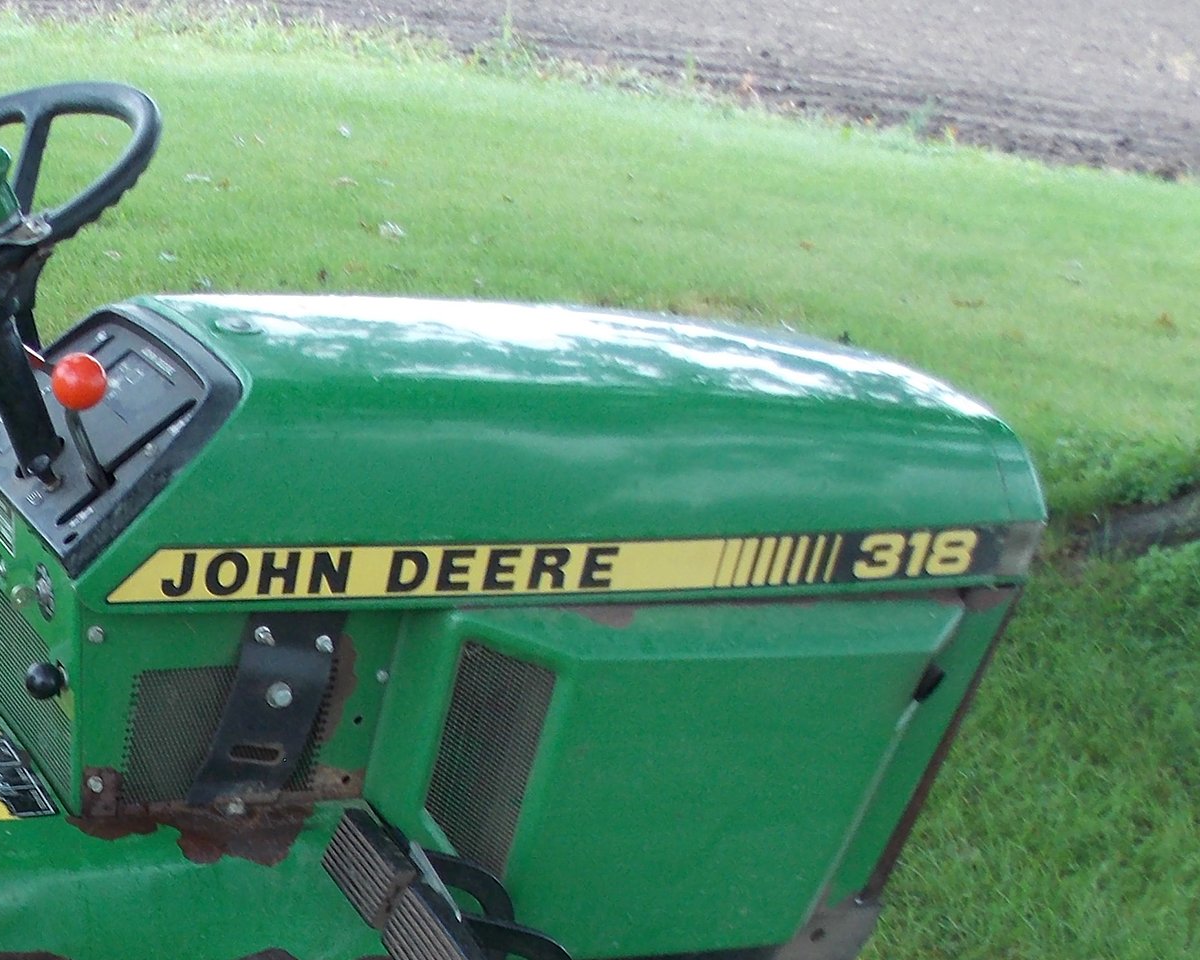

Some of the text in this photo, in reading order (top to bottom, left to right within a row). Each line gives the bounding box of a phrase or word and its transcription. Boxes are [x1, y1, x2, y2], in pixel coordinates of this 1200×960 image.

[161, 529, 977, 597] JOHN DEERE 318
